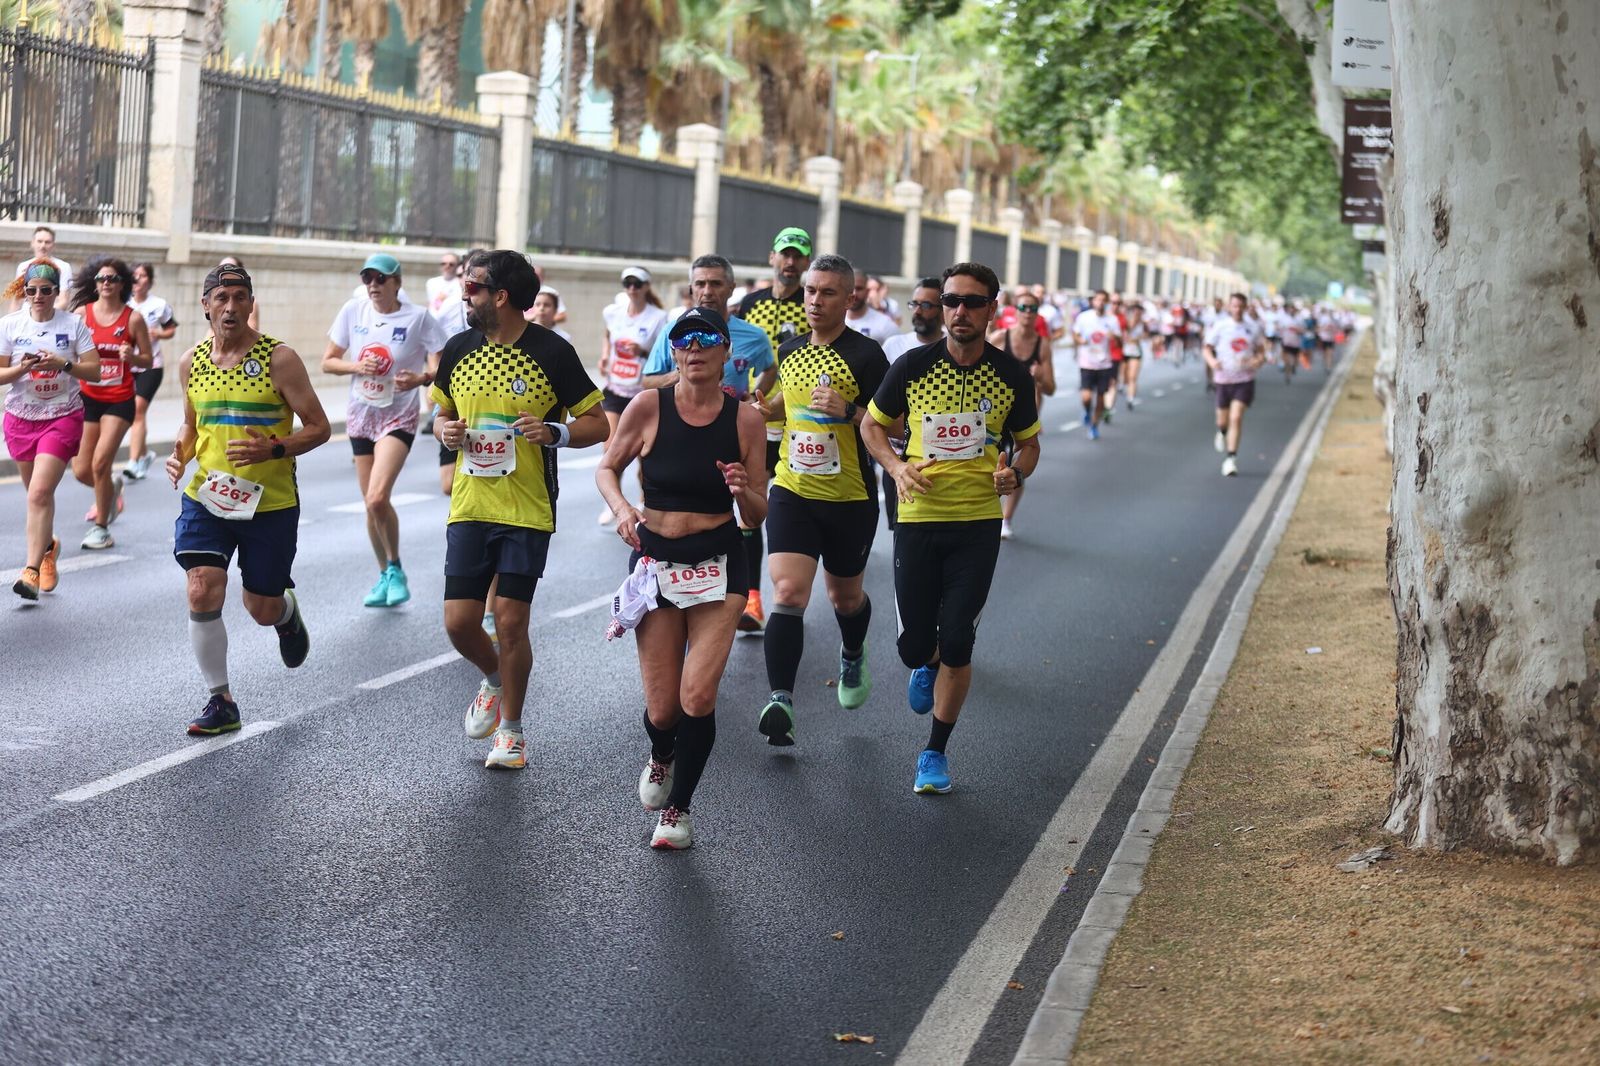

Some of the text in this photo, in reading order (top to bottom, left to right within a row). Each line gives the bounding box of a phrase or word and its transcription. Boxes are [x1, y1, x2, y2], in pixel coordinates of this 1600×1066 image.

[35, 383, 58, 392] 688
[937, 425, 971, 438] 260
[468, 441, 505, 454] 1042
[797, 442, 825, 455] 369
[209, 481, 252, 503] 1267
[670, 565, 720, 584] 1055
